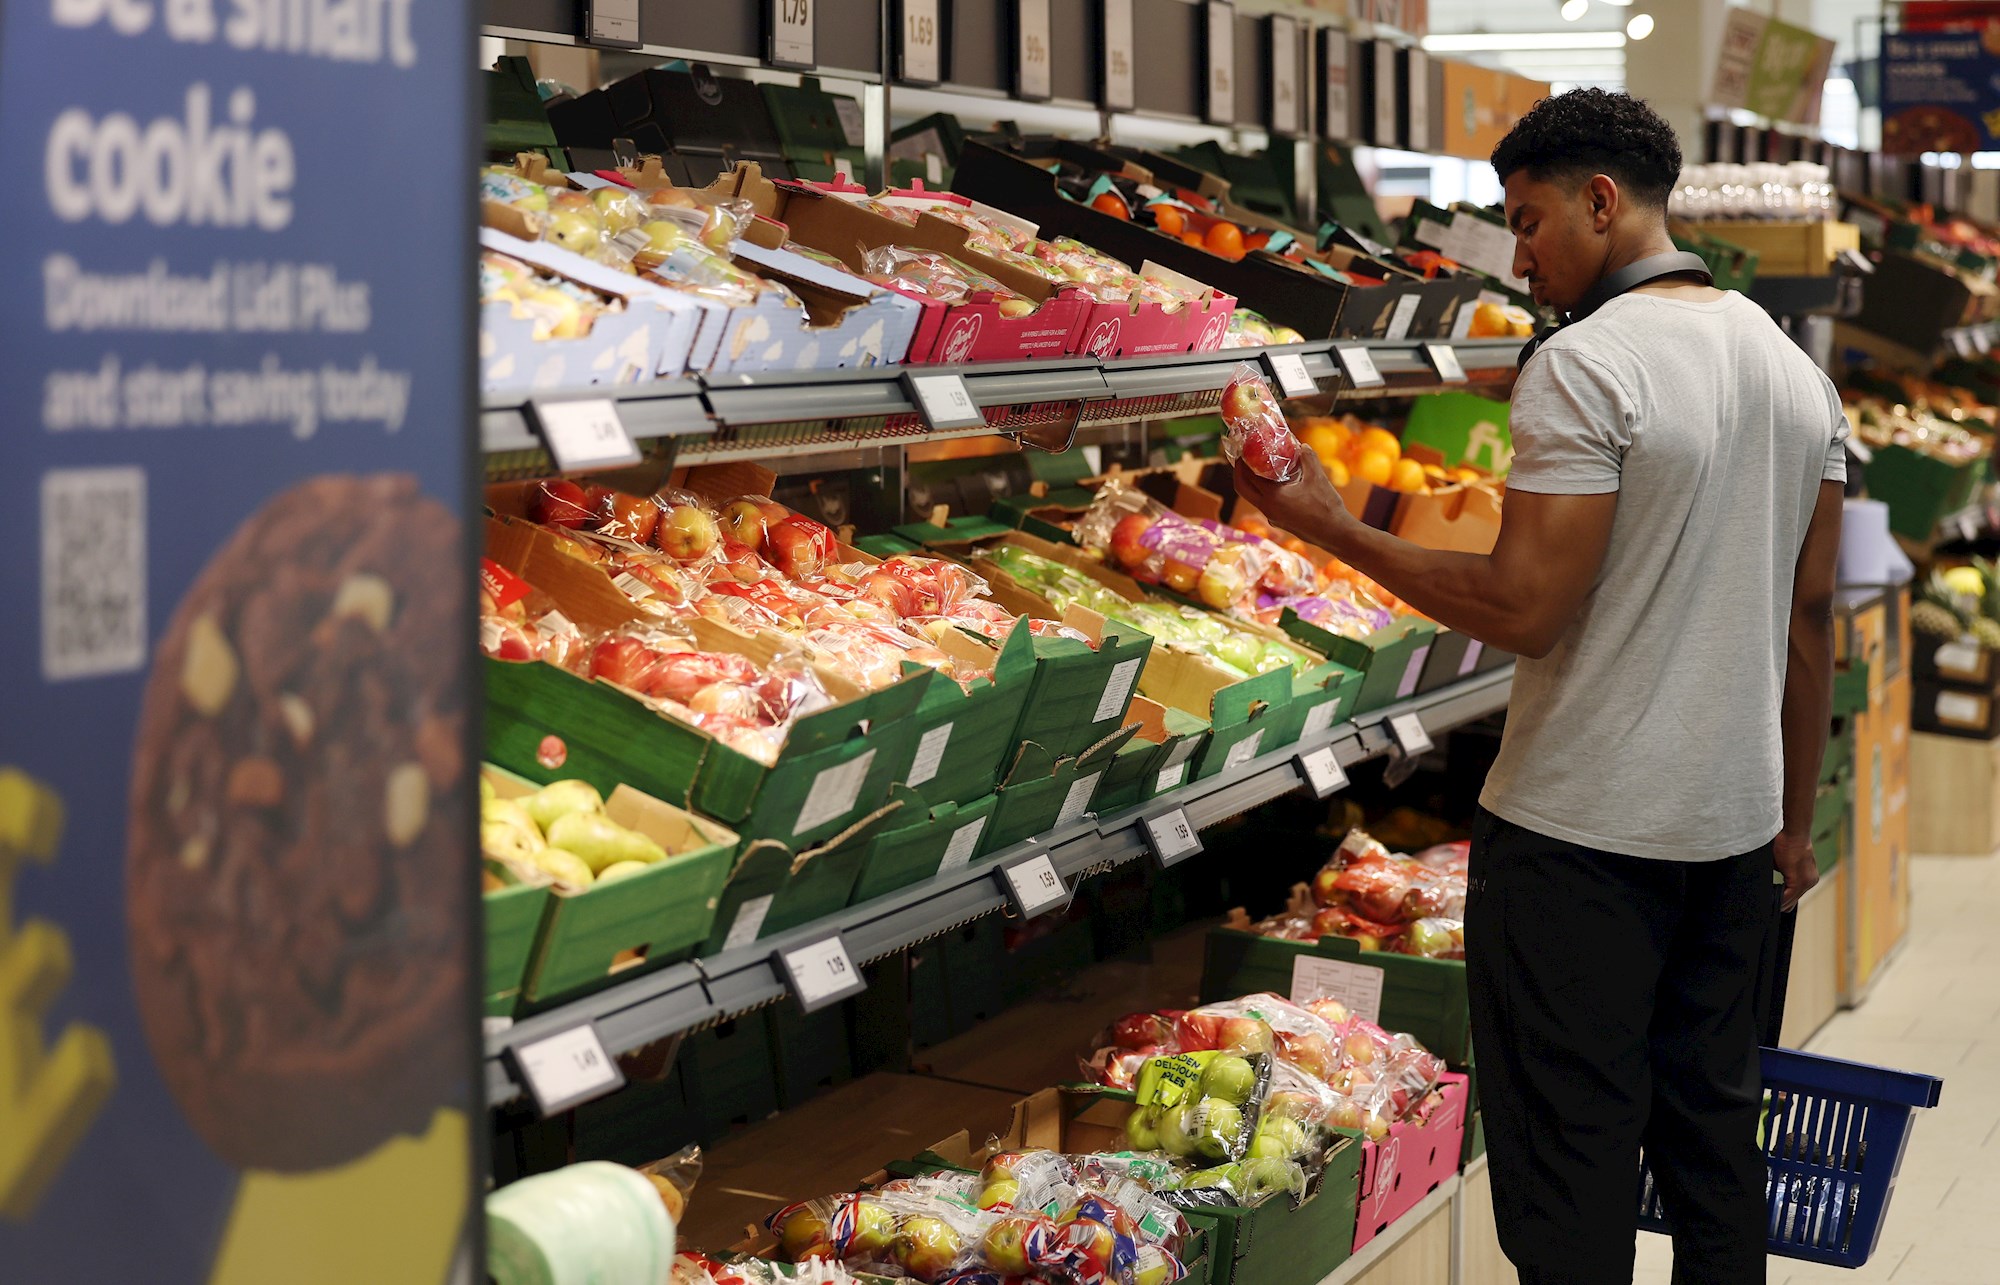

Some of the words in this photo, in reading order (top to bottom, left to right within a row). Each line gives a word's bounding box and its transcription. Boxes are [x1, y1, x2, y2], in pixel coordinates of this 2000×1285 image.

[782, 0, 808, 26] 1.79
[908, 14, 934, 46] 1.69
[45, 82, 296, 232] cookie
[43, 252, 229, 332] Download
[300, 263, 371, 333] Plus
[43, 353, 120, 434] and
[123, 362, 206, 428] start
[209, 352, 319, 441] saving
[321, 354, 411, 434] today
[1175, 823, 1189, 840] 1.59
[1039, 870, 1056, 889] 1.59
